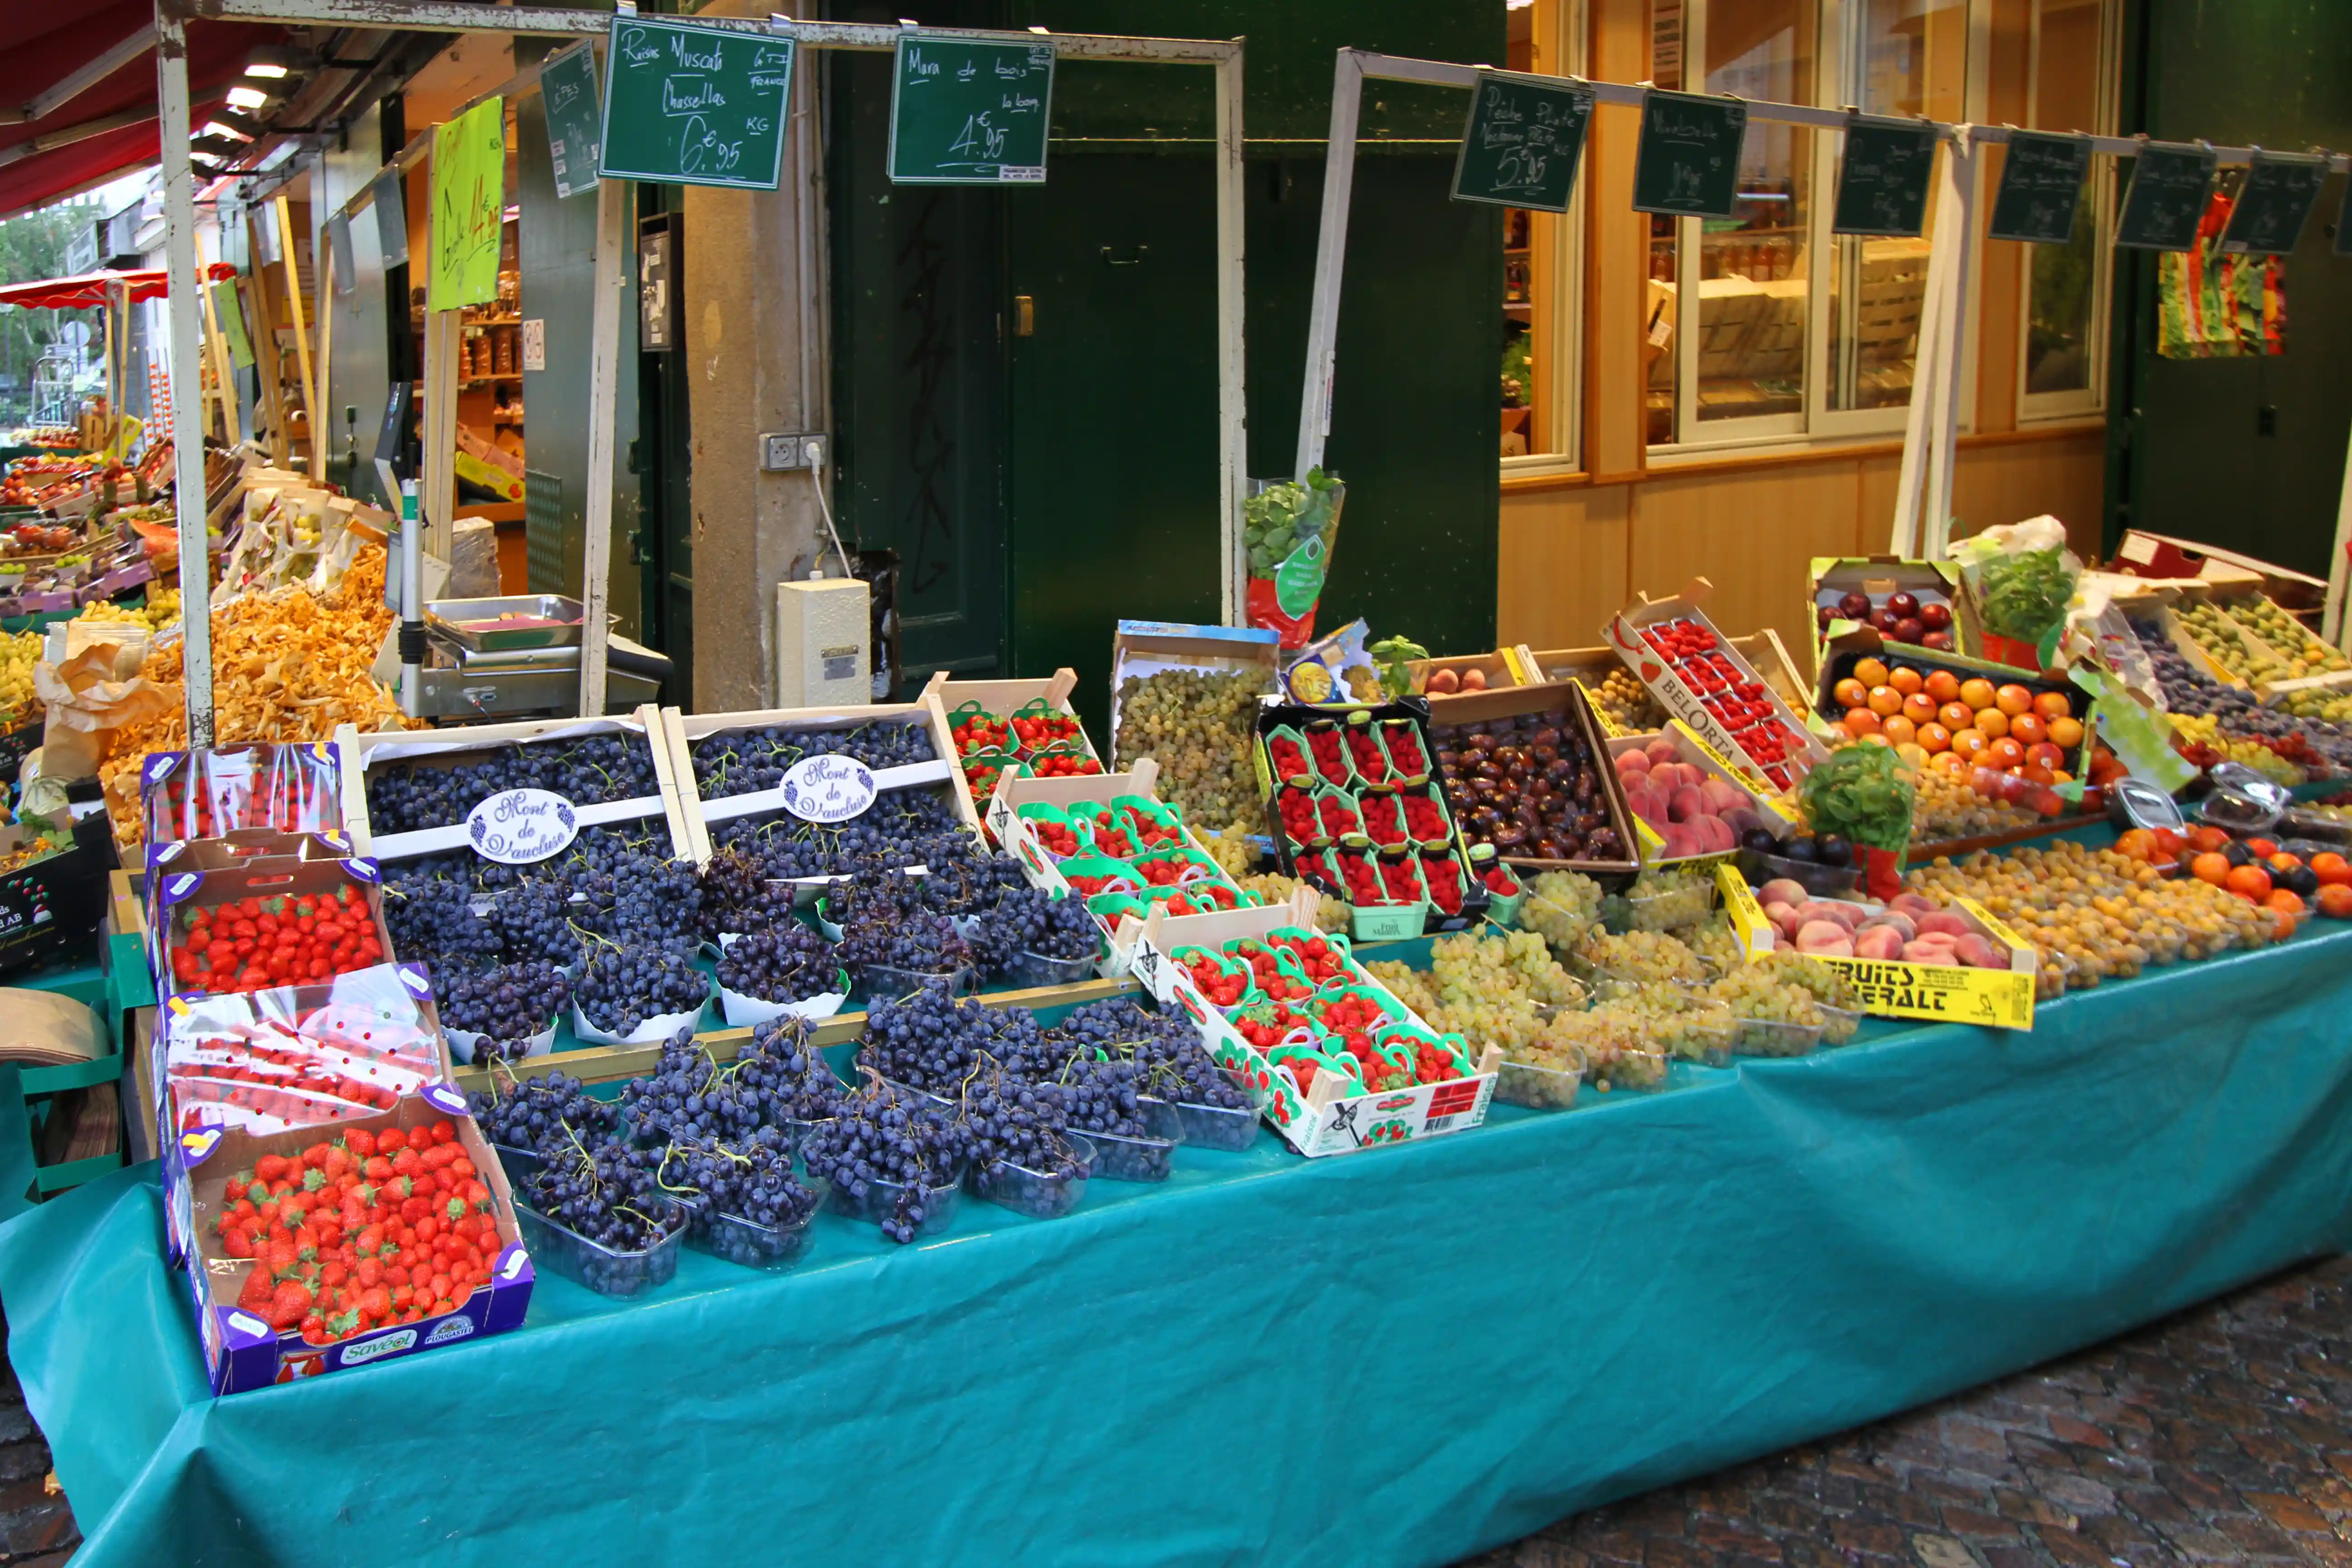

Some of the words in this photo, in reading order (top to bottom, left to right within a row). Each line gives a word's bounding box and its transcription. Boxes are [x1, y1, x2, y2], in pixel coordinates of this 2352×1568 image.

[621, 28, 660, 61] Raisins
[909, 48, 940, 75] Mara
[957, 60, 976, 76] de
[995, 57, 1027, 77] bois
[750, 76, 785, 89] FRANCE
[746, 116, 769, 132] KG
[1661, 678, 1735, 761] BELORTA
[803, 757, 850, 787] Mont
[494, 790, 550, 823] Mont
[1471, 1073, 1497, 1123] Fraises
[346, 1333, 411, 1359] Savéol
[426, 1325, 474, 1344] PLOUGASTEL
